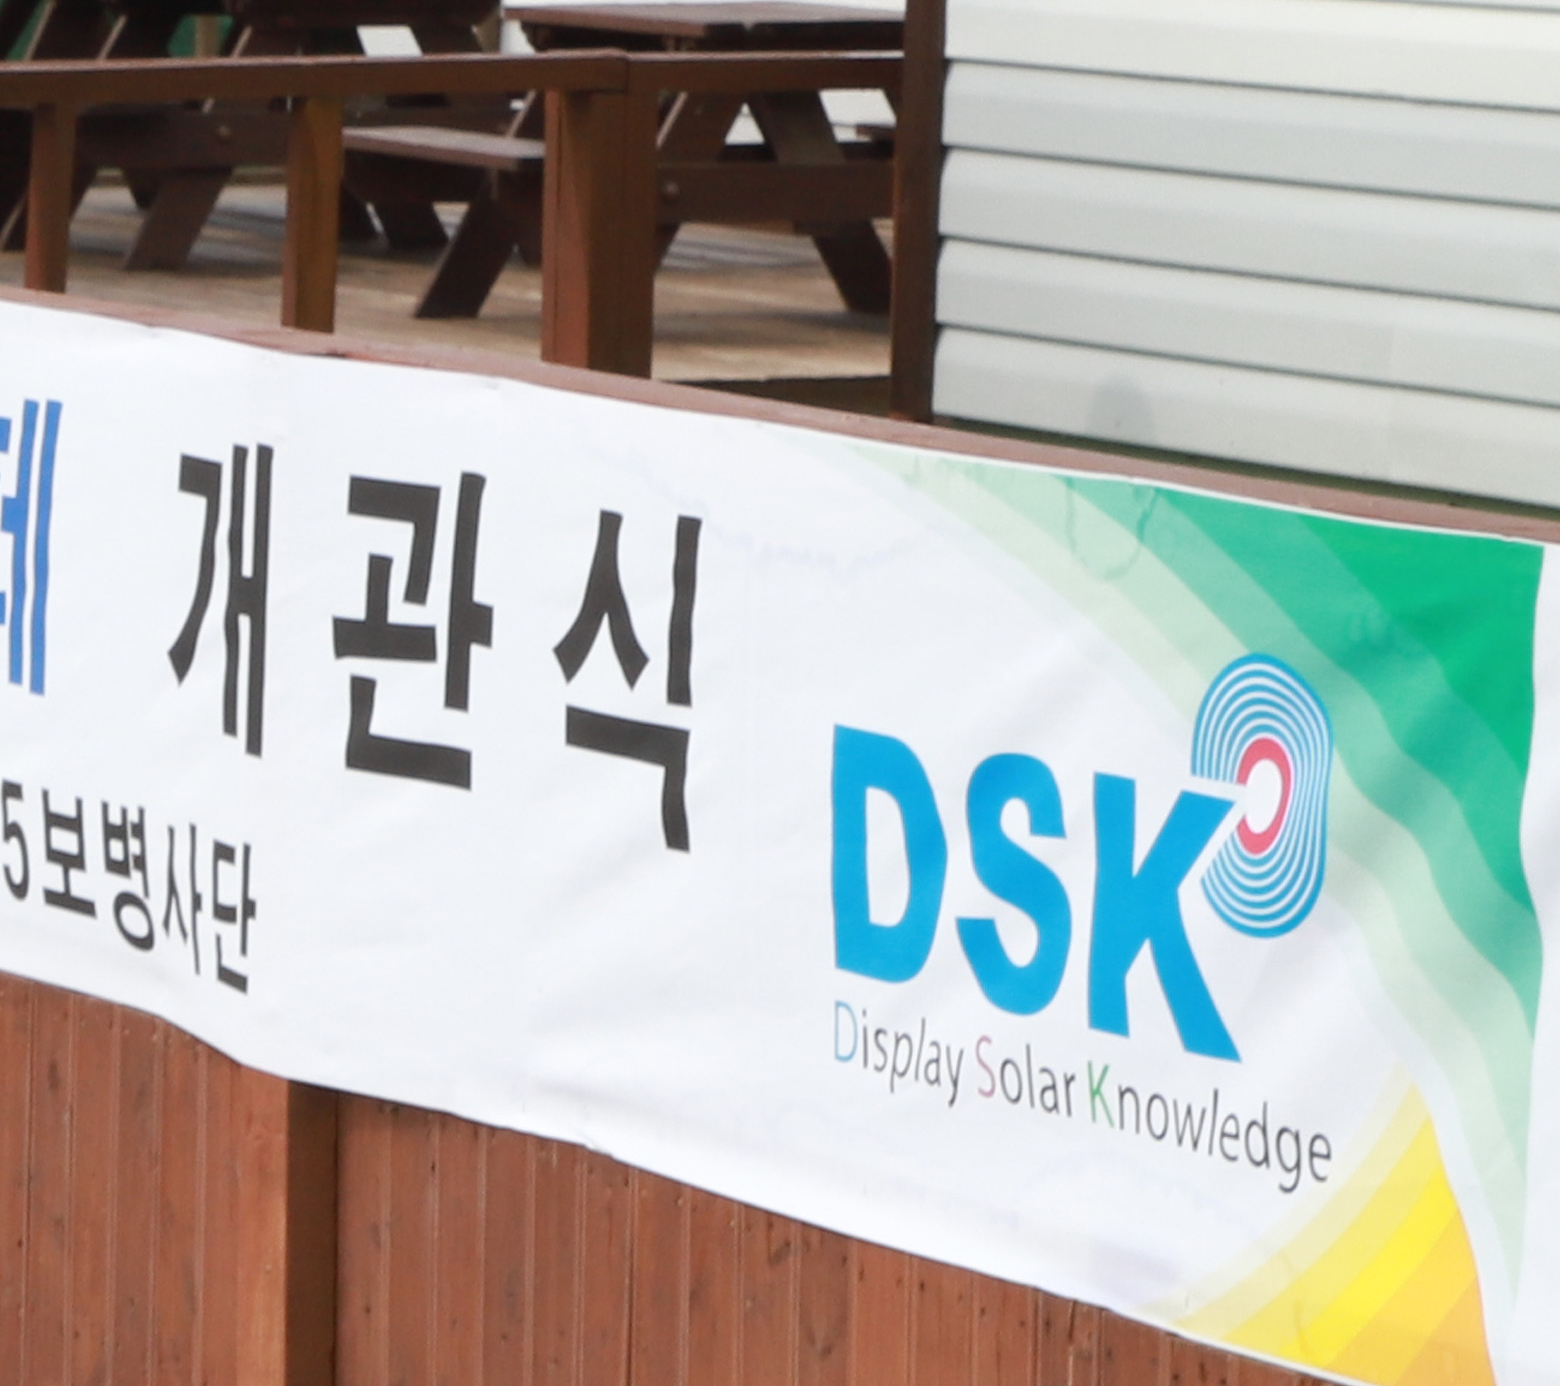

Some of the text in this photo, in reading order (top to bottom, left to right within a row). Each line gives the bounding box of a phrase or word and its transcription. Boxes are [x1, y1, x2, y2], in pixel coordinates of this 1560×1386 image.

[167, 442, 703, 854] 개관식
[1, 778, 257, 995] 5보병사단
[830, 722, 1243, 1064] DSK
[833, 999, 1333, 1194] Display Solar Knowledge
